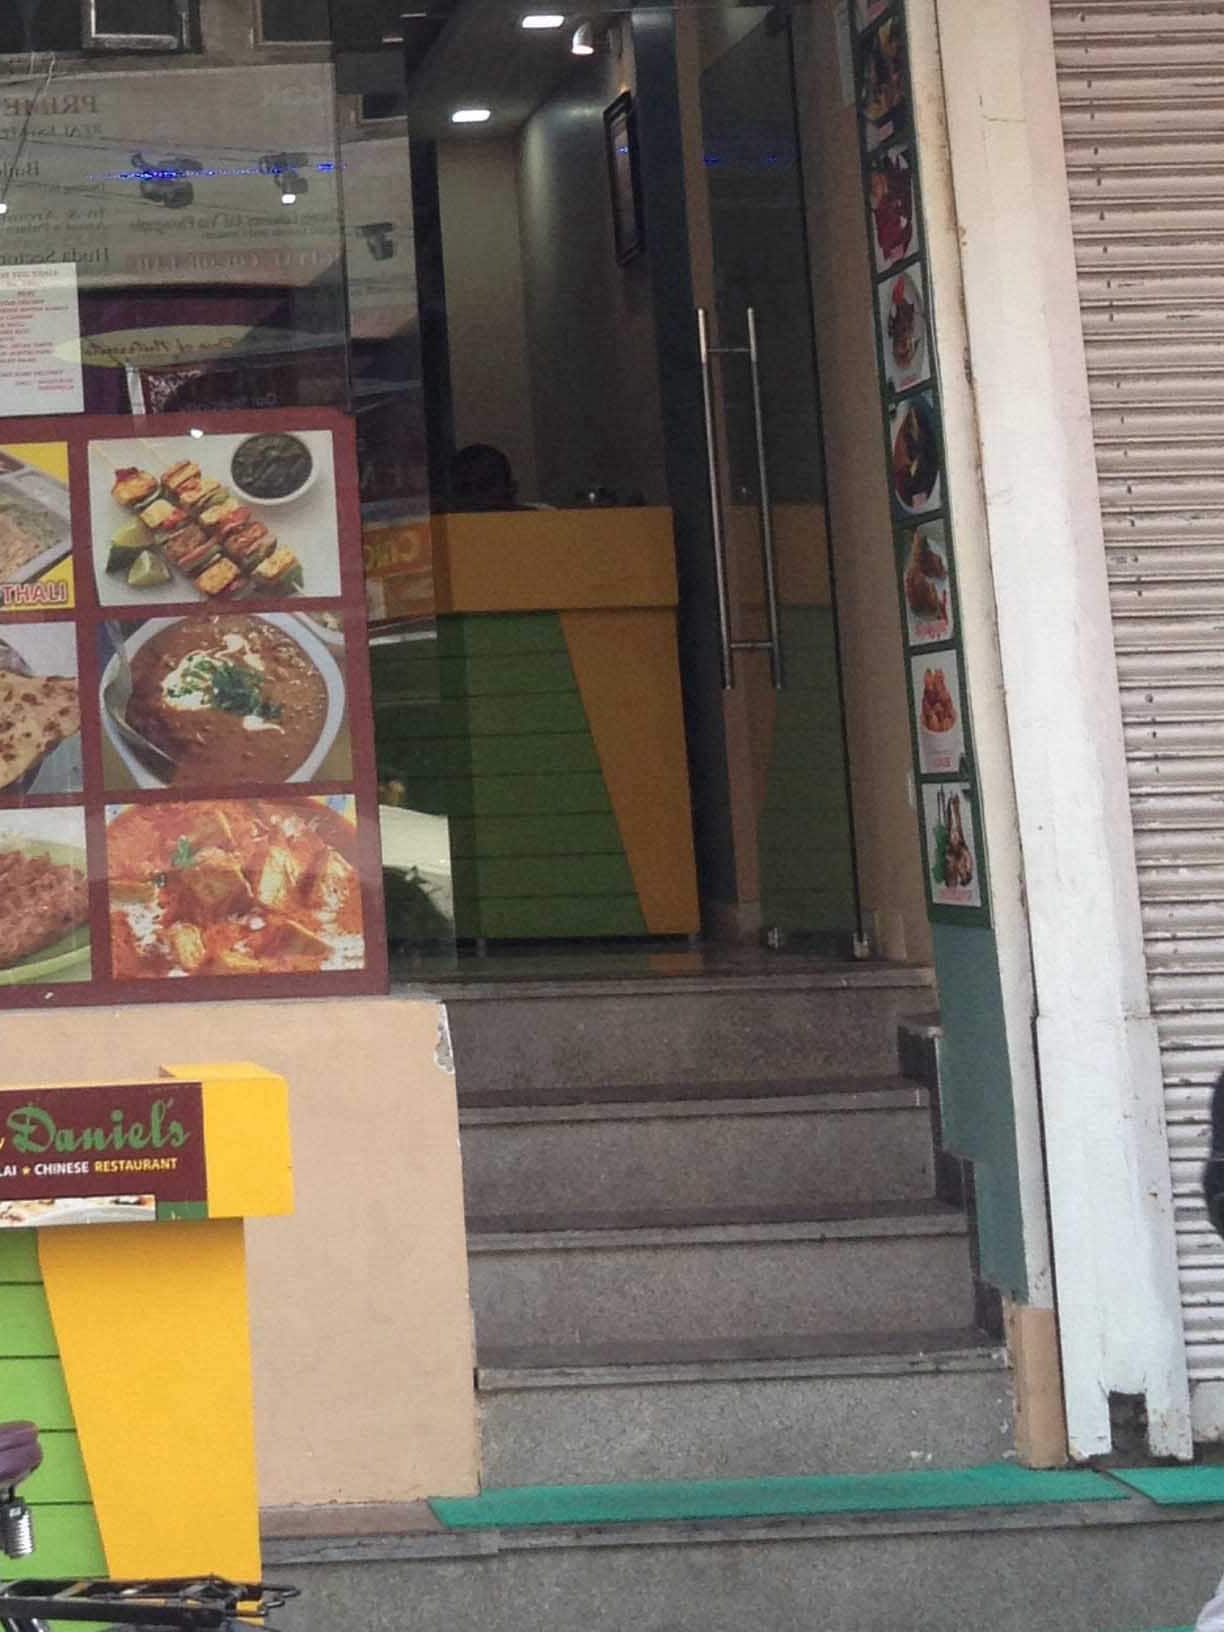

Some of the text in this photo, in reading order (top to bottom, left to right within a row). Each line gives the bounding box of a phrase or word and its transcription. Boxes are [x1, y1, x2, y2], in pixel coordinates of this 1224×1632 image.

[1, 581, 68, 606] THALI
[6, 1098, 191, 1154] Daniel's
[34, 1161, 90, 1176] CHINESE
[94, 1157, 178, 1173] RESTAURANT
